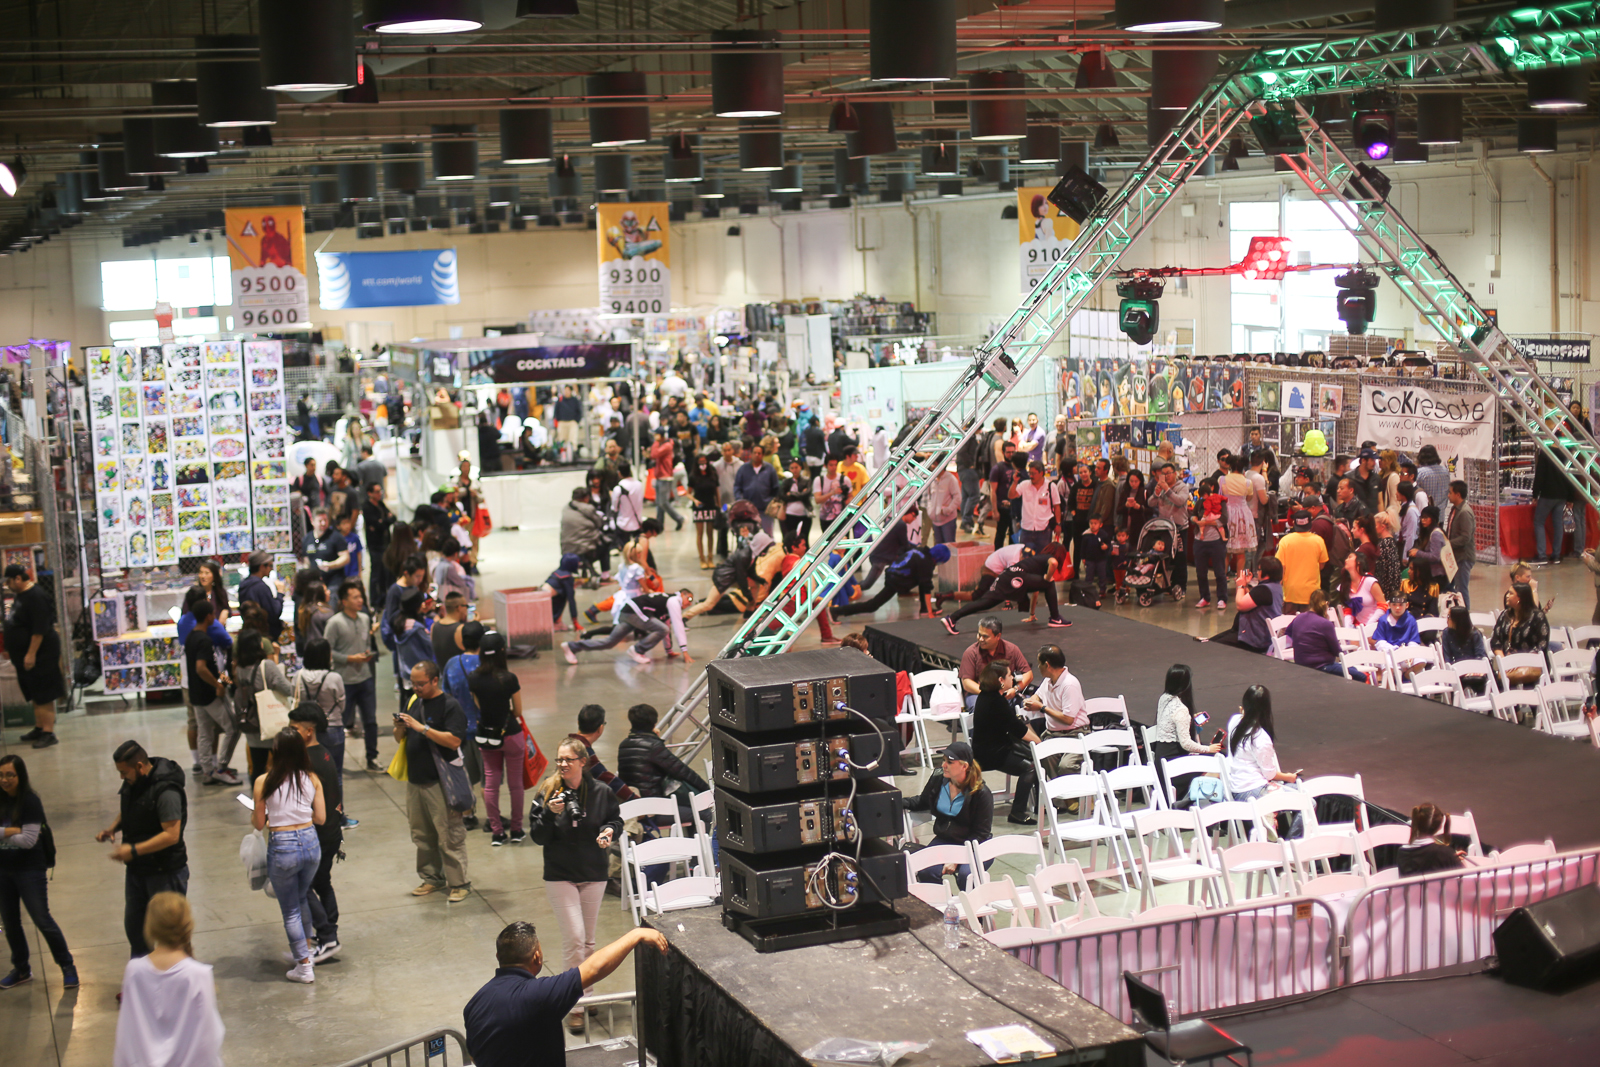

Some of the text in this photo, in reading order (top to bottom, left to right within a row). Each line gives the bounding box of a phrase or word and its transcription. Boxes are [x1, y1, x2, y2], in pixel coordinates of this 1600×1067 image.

[240, 275, 296, 293] 9500
[610, 268, 661, 284] 9300
[611, 299, 662, 315] 9400
[242, 308, 298, 326] 9600
[516, 356, 586, 371] COCKTAILS
[1394, 436, 1409, 448] 3D
